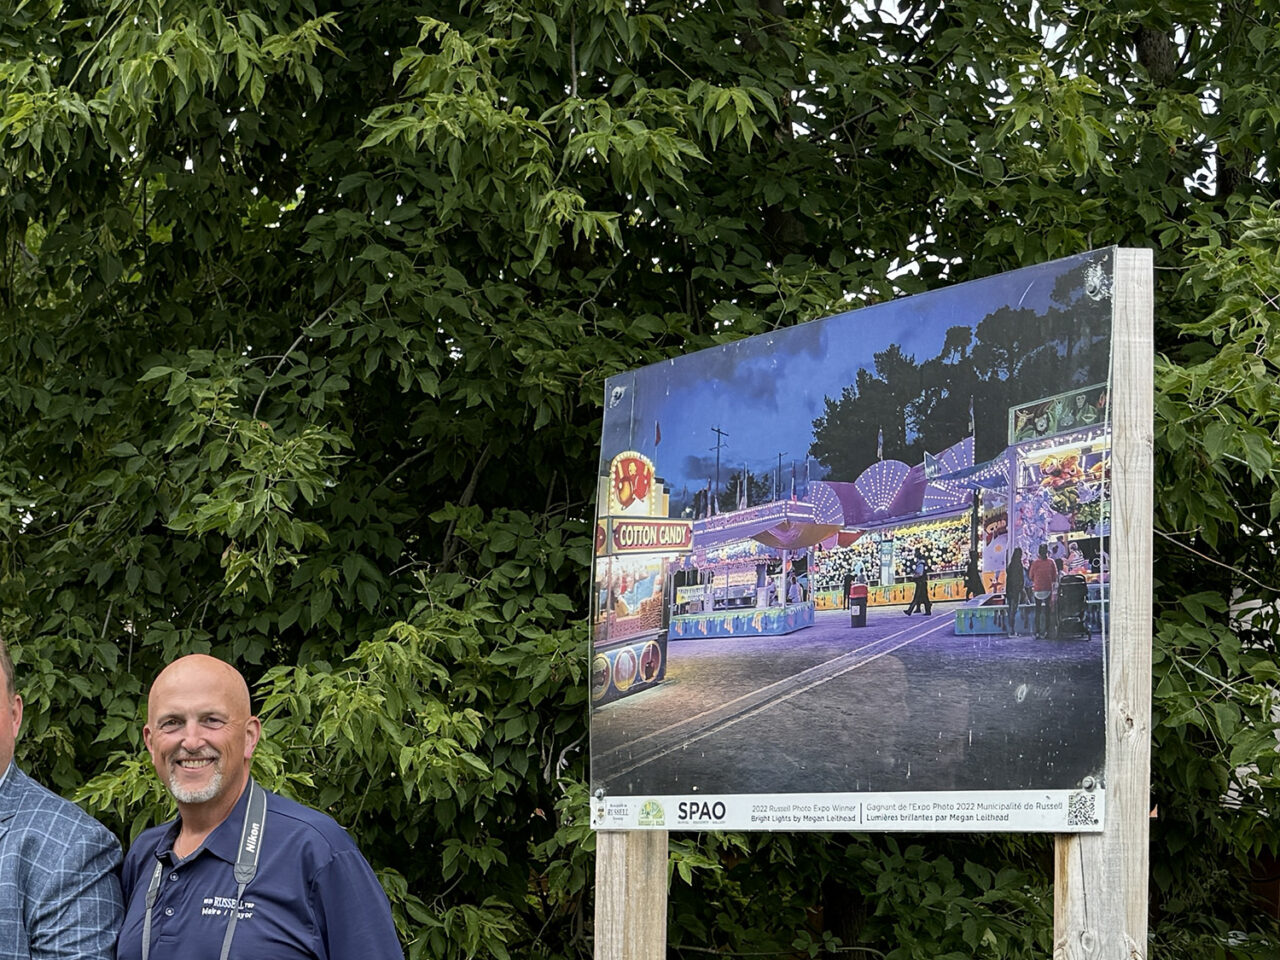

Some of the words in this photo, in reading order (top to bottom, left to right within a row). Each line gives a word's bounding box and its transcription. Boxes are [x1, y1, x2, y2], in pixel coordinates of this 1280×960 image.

[620, 524, 657, 546] COTTON
[659, 525, 687, 544] CANDY
[678, 801, 726, 820] SPAO
[769, 804, 791, 812] Russell
[792, 804, 812, 812] Photo
[813, 804, 831, 814] Expo
[832, 804, 856, 812] Winner
[866, 802, 897, 814] Gagnant
[898, 803, 907, 811] de
[932, 803, 955, 811] Photo
[956, 803, 975, 811] 2022
[976, 802, 1022, 812] Municipalité
[1023, 802, 1034, 810] de
[1036, 802, 1063, 810] Russell
[751, 815, 770, 824] Bright
[772, 815, 792, 824] Lights
[793, 815, 801, 823] by
[803, 815, 825, 823] Megan
[900, 813, 933, 821] brillantes
[935, 815, 947, 823] par
[949, 813, 974, 823] Megan
[976, 813, 1009, 821] Leithead
[245, 823, 260, 853] Nikon
